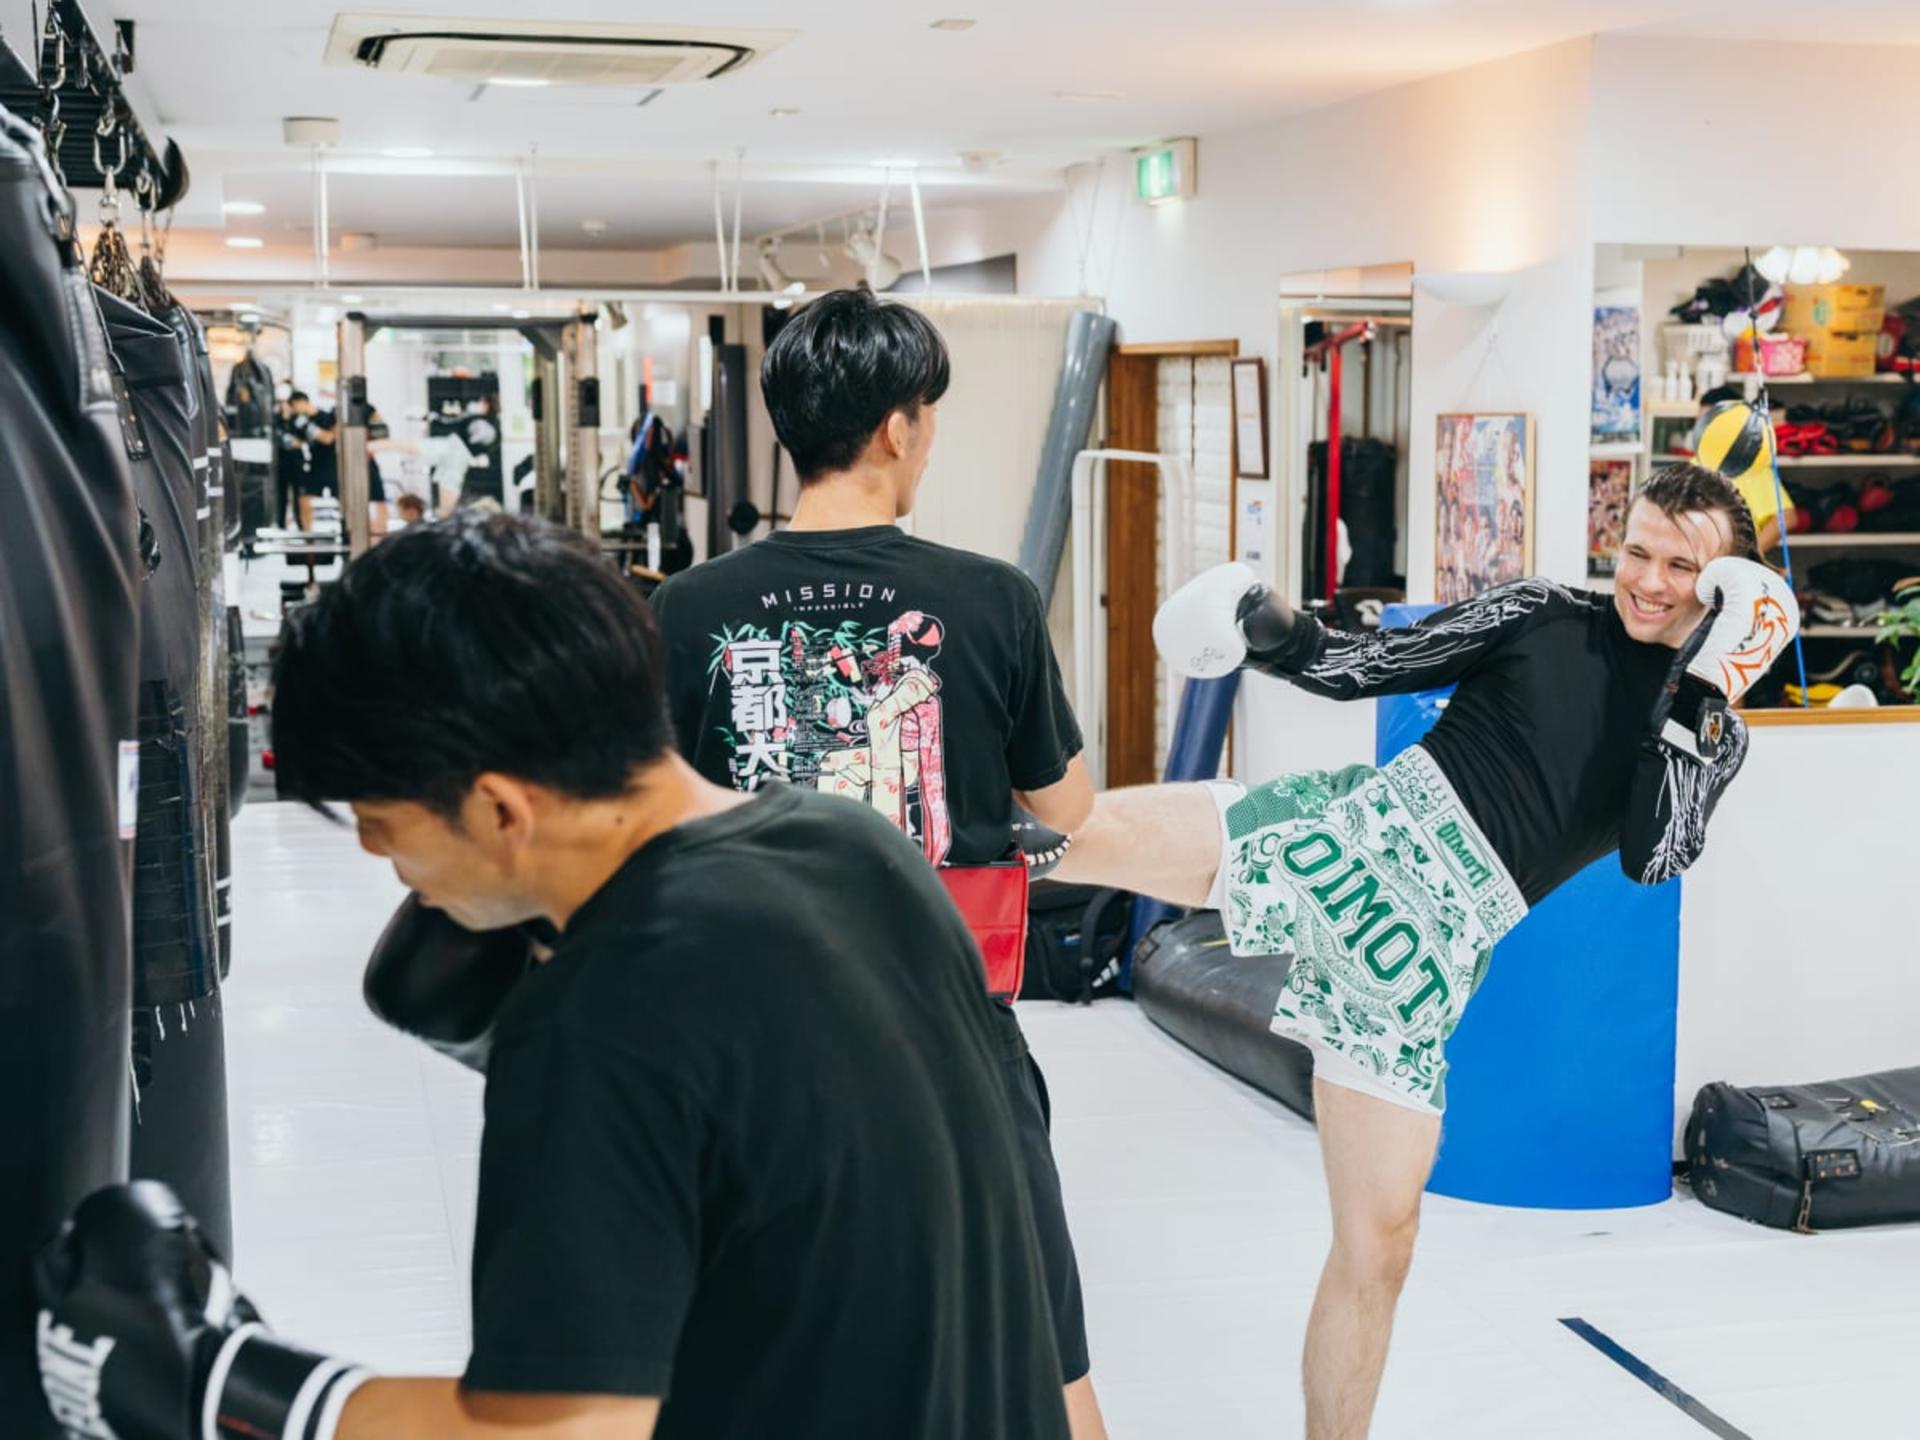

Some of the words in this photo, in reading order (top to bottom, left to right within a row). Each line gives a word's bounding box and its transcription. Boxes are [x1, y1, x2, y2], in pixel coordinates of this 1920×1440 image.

[761, 583, 896, 609] MISSION
[728, 638, 791, 791] 京都大
